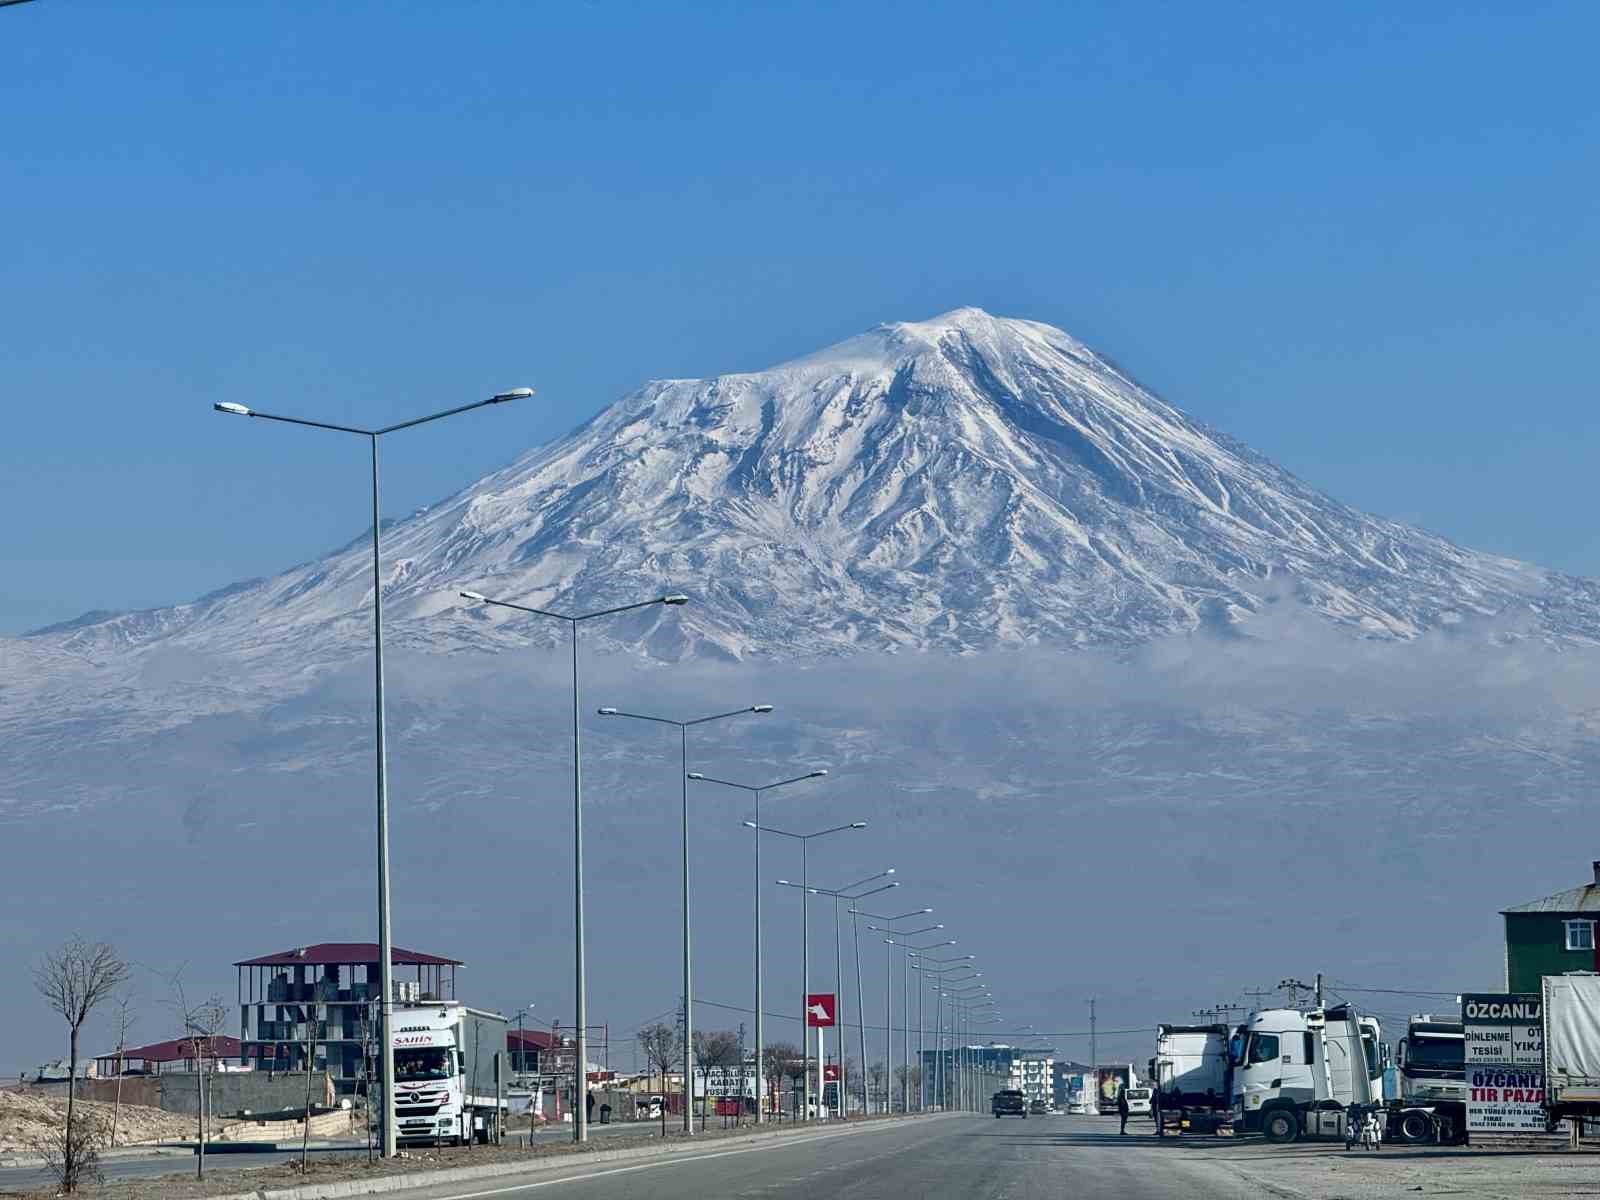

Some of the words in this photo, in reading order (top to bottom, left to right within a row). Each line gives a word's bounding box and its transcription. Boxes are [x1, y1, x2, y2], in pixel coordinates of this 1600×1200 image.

[1465, 1031, 1510, 1041] DİNLENME
[1472, 1045, 1503, 1055] TESİSİ
[1470, 1089, 1498, 1101] TIR
